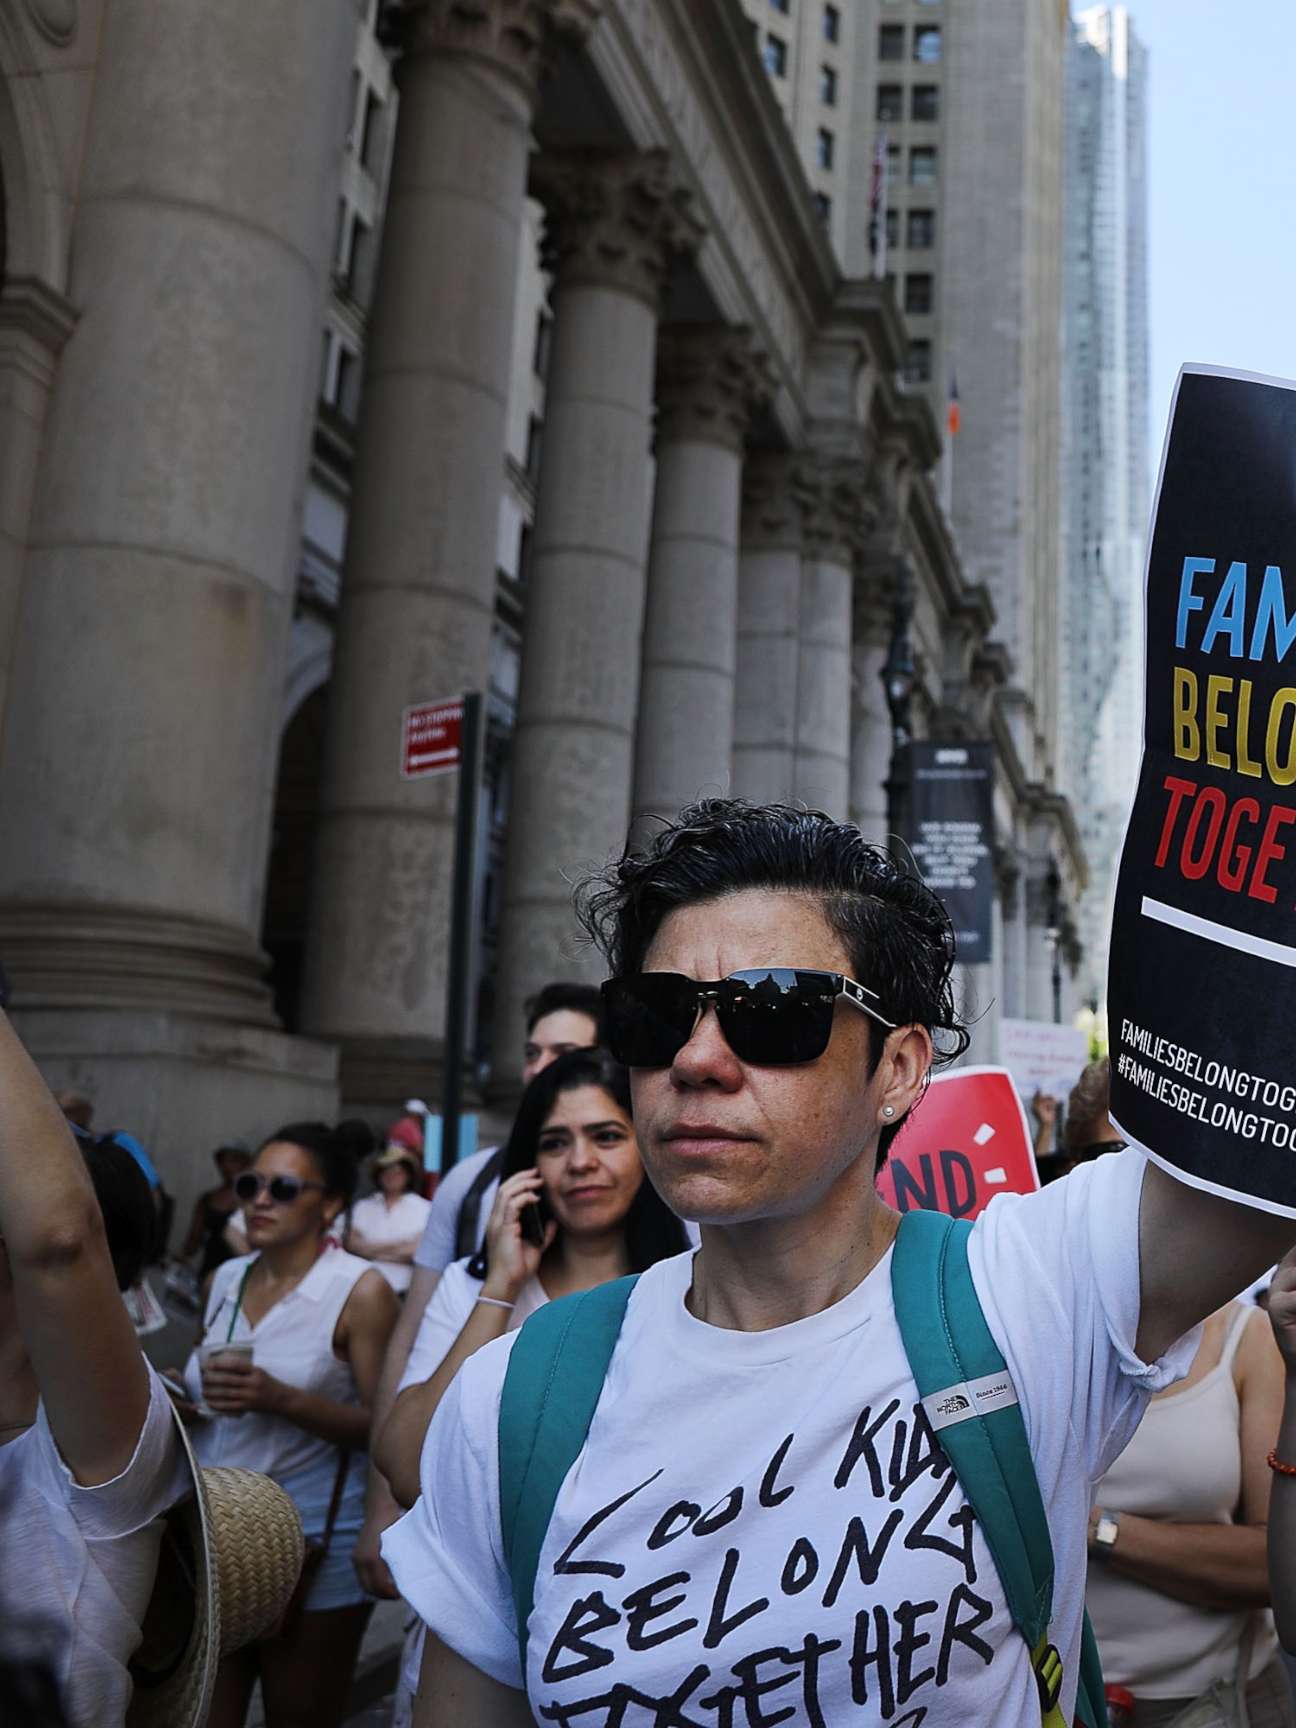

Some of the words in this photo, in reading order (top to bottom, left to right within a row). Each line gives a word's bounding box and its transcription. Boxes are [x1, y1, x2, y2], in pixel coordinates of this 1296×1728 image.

[874, 1150, 977, 1219] ND
[834, 1398, 952, 1502] KID
[542, 1466, 978, 1683] BELONG
